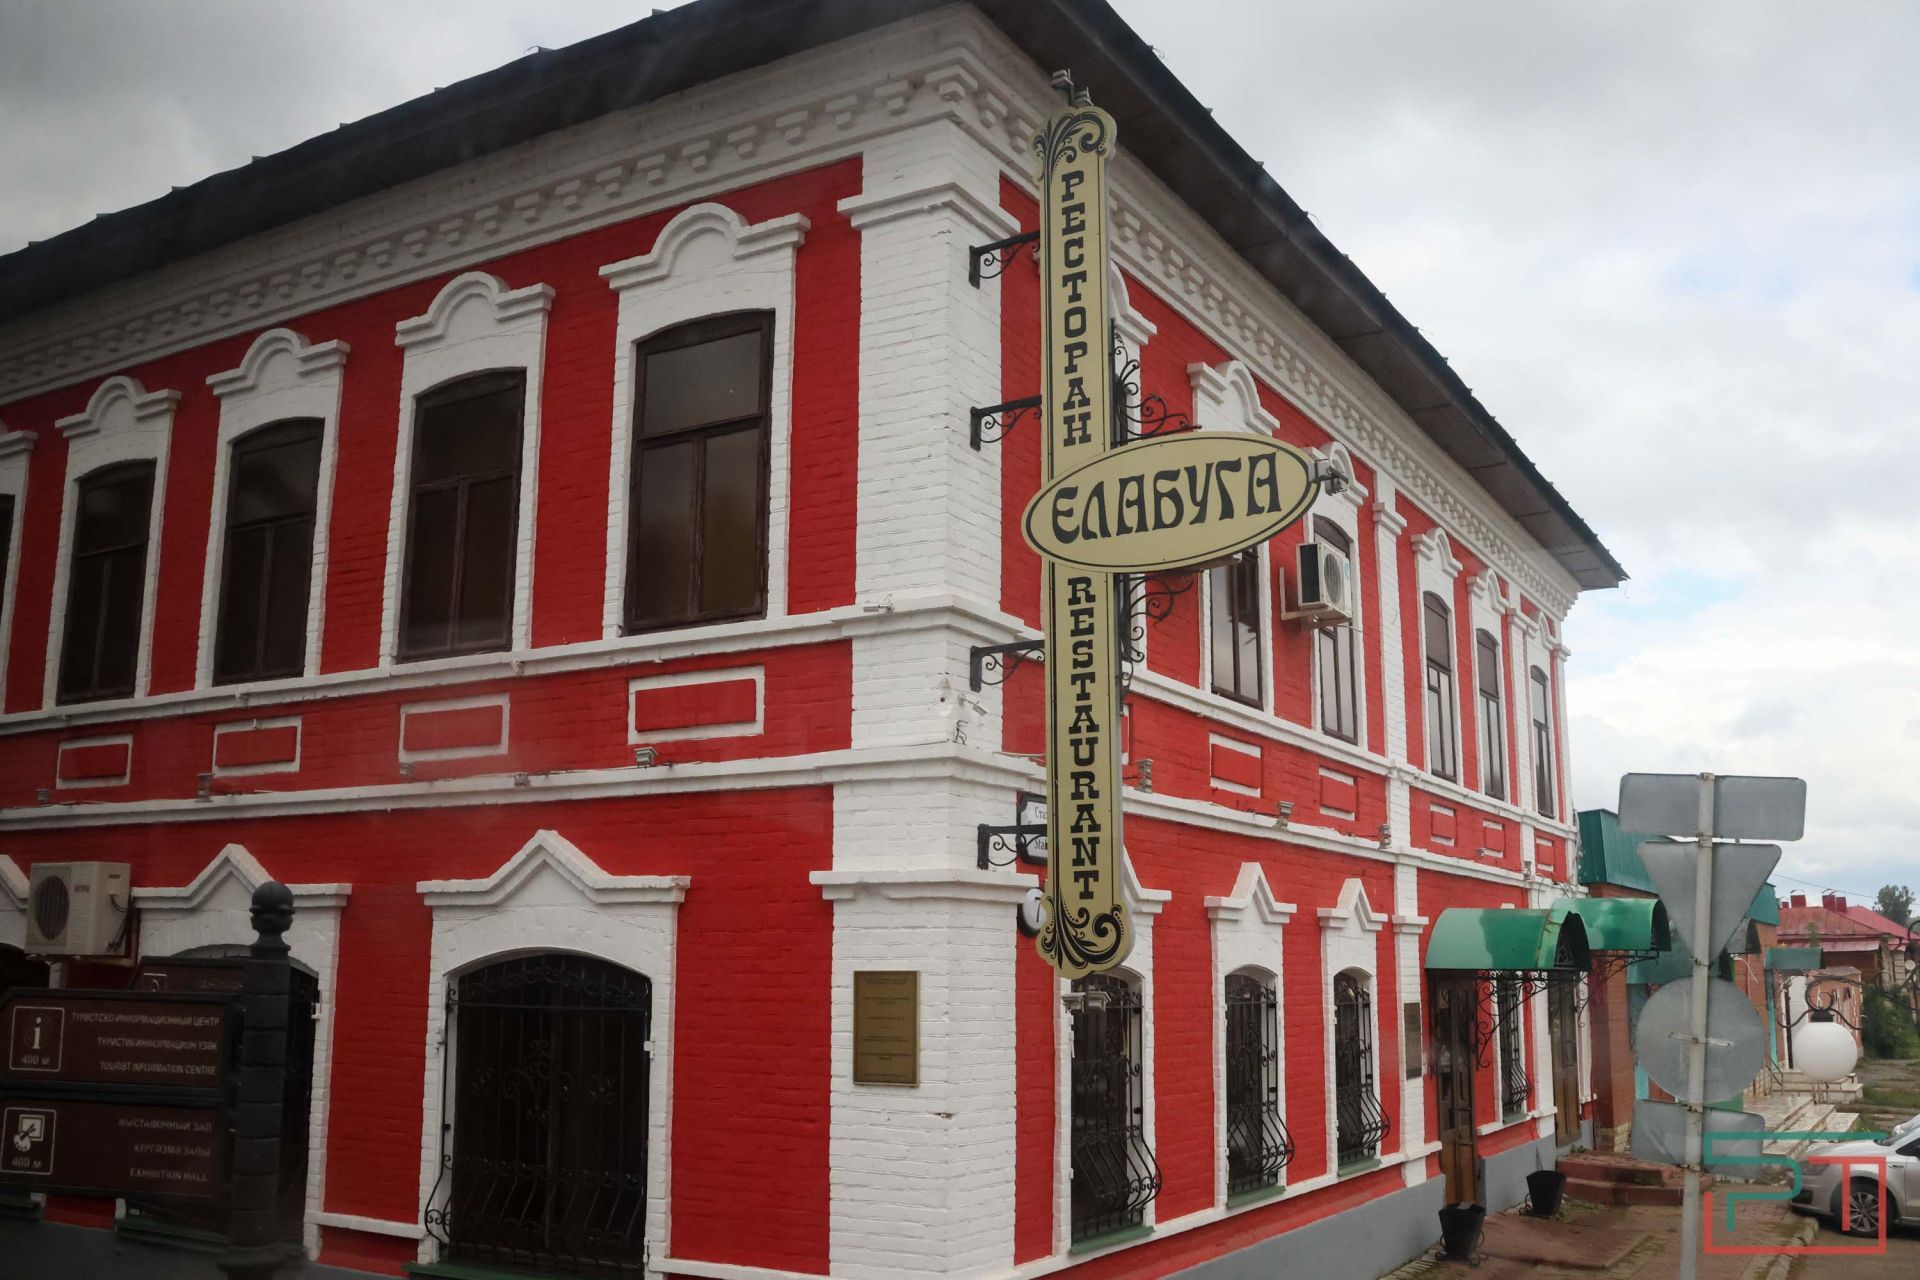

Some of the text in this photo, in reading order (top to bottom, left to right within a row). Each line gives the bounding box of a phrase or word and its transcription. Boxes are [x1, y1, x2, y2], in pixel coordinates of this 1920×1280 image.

[1061, 170, 1092, 447] РЕСТОРАН
[1051, 451, 1282, 545] ЕЛАБУГА
[1067, 576, 1102, 900] RESTAURANT
[193, 1016, 220, 1027] ЦЕНТР
[21, 1054, 39, 1065] 400
[100, 1061, 216, 1076] TOURIST INFORMATION CENTRE
[192, 1121, 212, 1133] ЗАЛ
[11, 1157, 30, 1168] 400
[129, 1167, 208, 1183] EXHIBITION HALL
